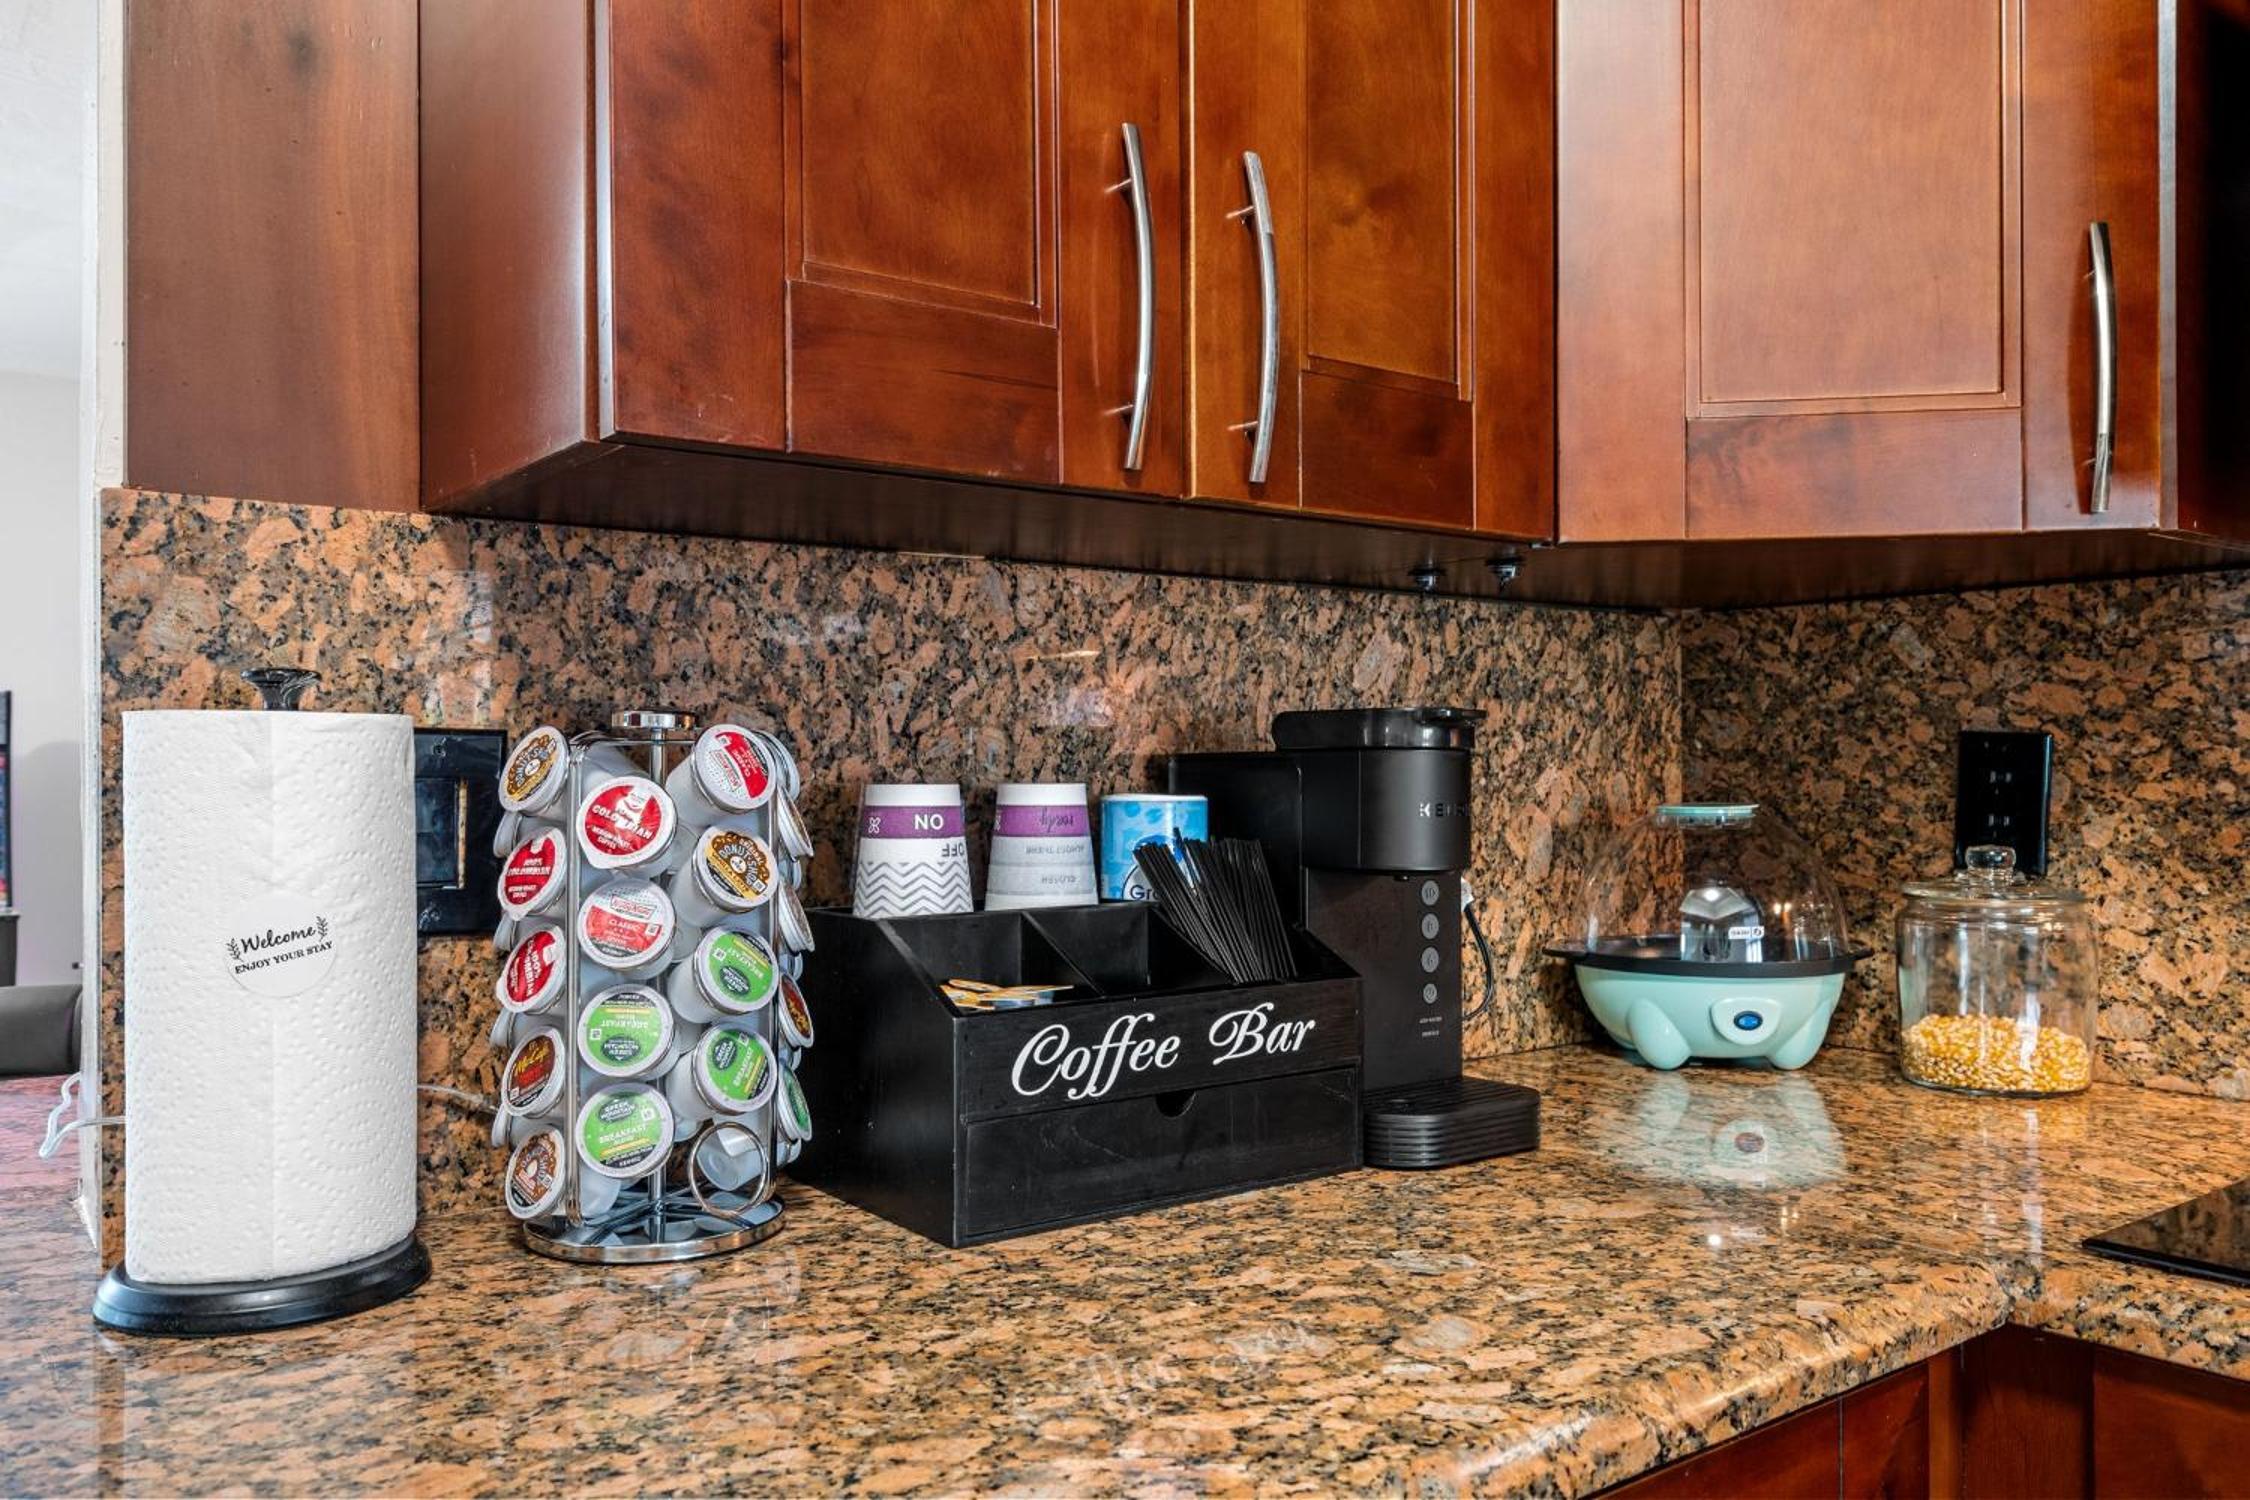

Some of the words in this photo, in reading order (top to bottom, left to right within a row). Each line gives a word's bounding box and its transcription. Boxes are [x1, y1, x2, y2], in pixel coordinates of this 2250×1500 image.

[234, 957, 271, 975] ENJOY
[273, 949, 305, 964] YOUR
[306, 940, 333, 956] STAY
[240, 926, 316, 954] Welcome
[1010, 1012, 1182, 1101] Coffee
[1207, 1001, 1317, 1066] Bar
